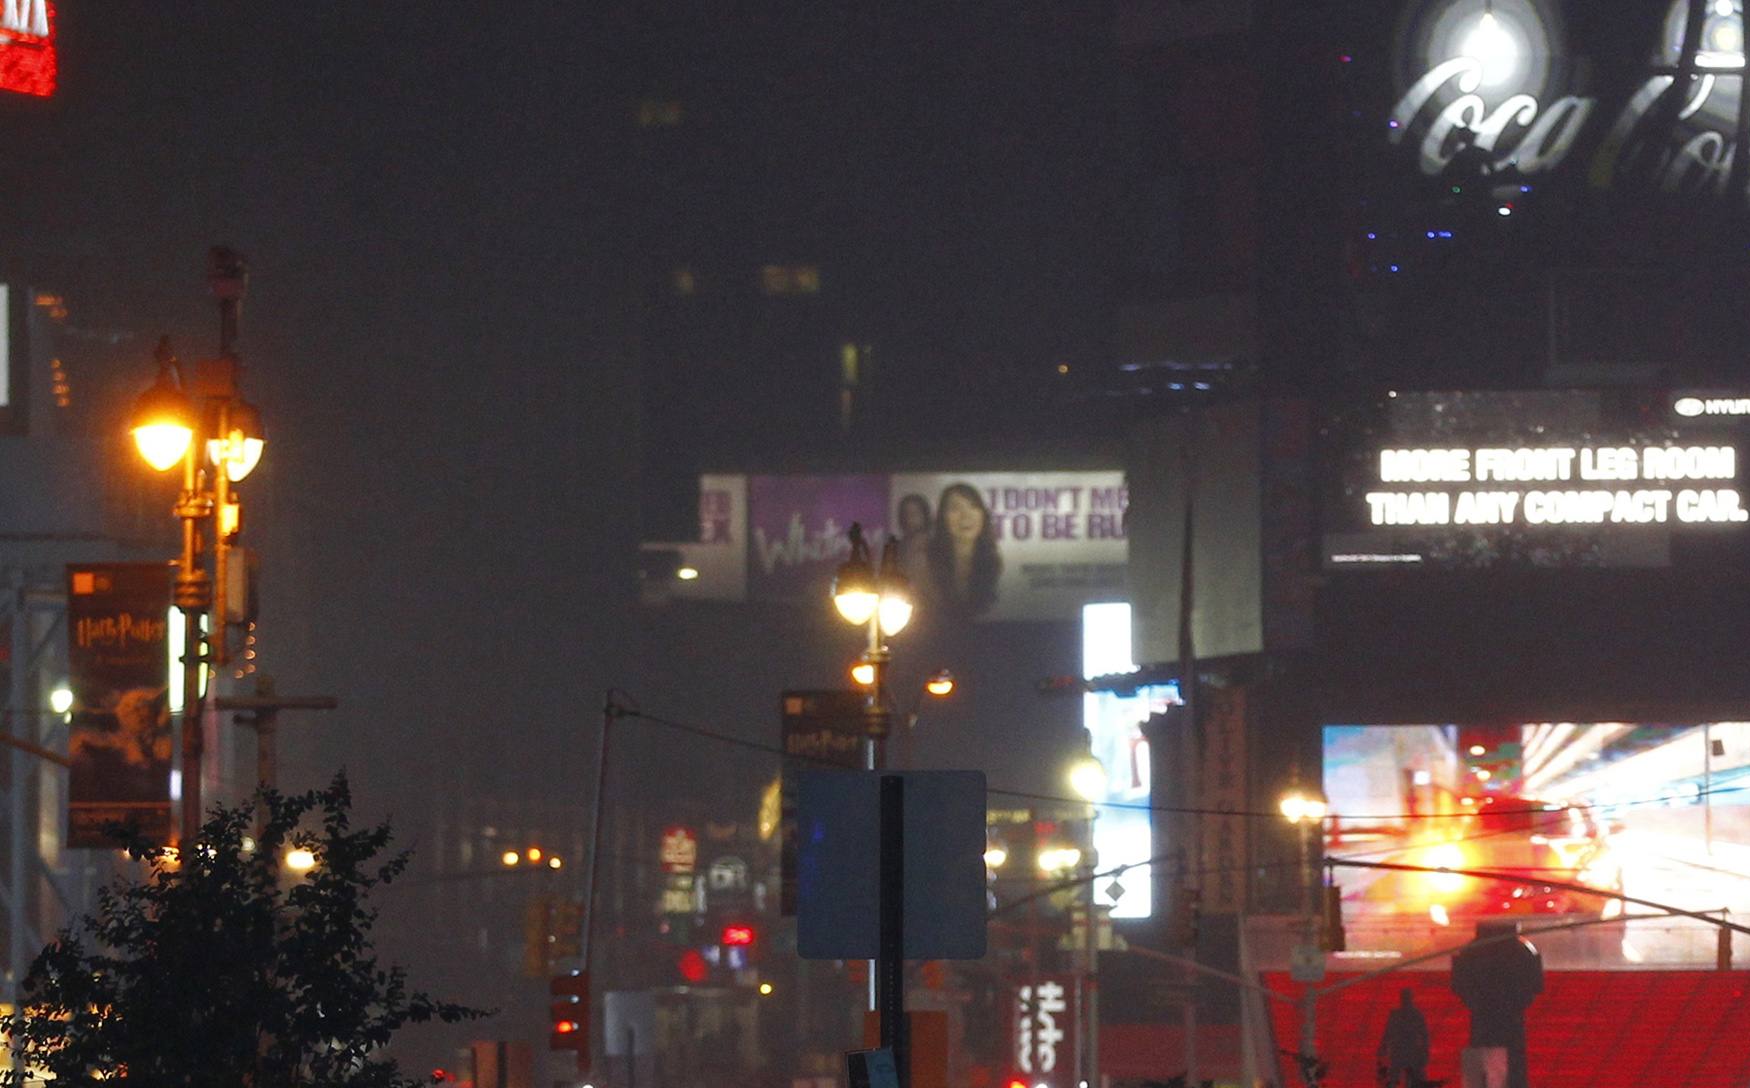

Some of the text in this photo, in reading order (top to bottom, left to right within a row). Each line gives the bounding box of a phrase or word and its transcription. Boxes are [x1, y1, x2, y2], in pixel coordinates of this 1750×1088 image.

[1388, 56, 1592, 174] Coca
[1380, 446, 1735, 481] MORE FRONT LEG ROOM
[1366, 489, 1748, 524] THAN ANY COMPACT CAR.
[991, 514, 1031, 540] TO
[1042, 514, 1077, 540] BE
